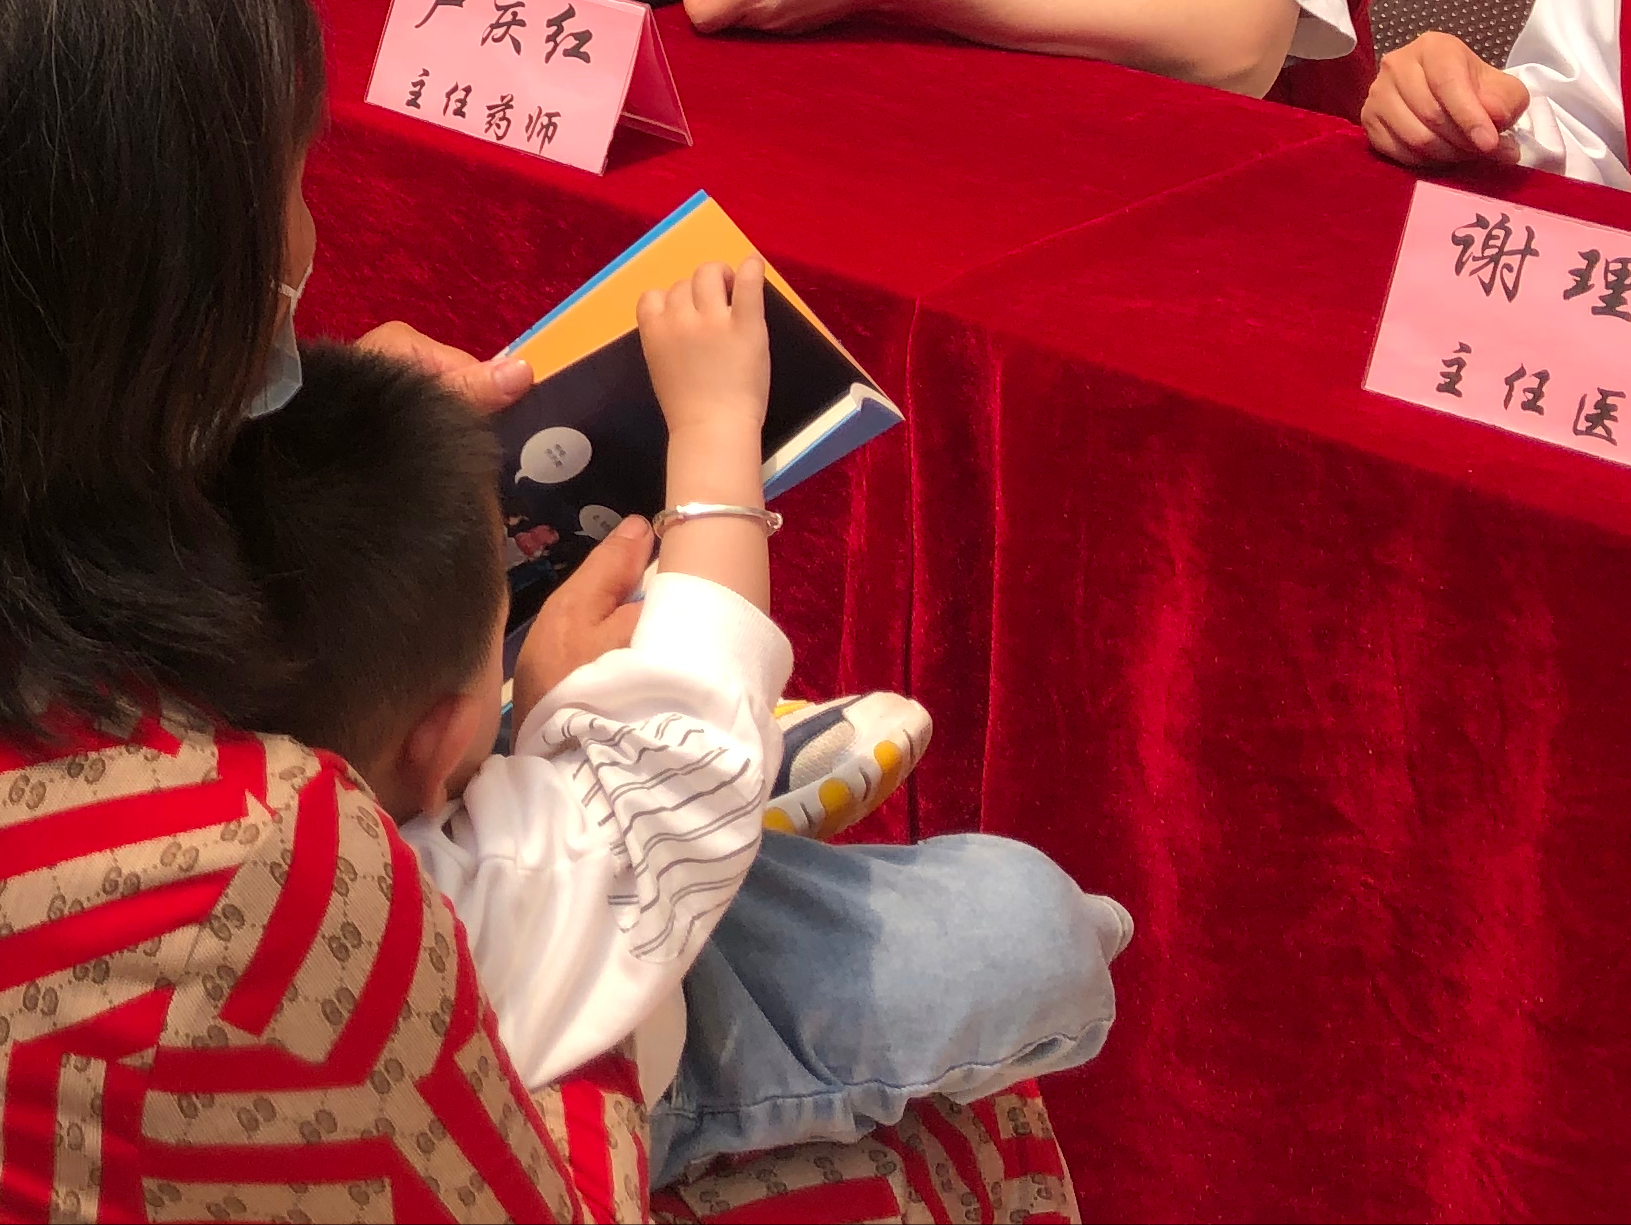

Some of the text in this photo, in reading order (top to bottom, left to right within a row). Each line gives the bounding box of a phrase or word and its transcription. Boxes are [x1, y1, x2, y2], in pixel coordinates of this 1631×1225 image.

[405, 68, 562, 155] 主任药师
[1451, 212, 1631, 322] 谢理
[1435, 341, 1626, 446] 主任医
